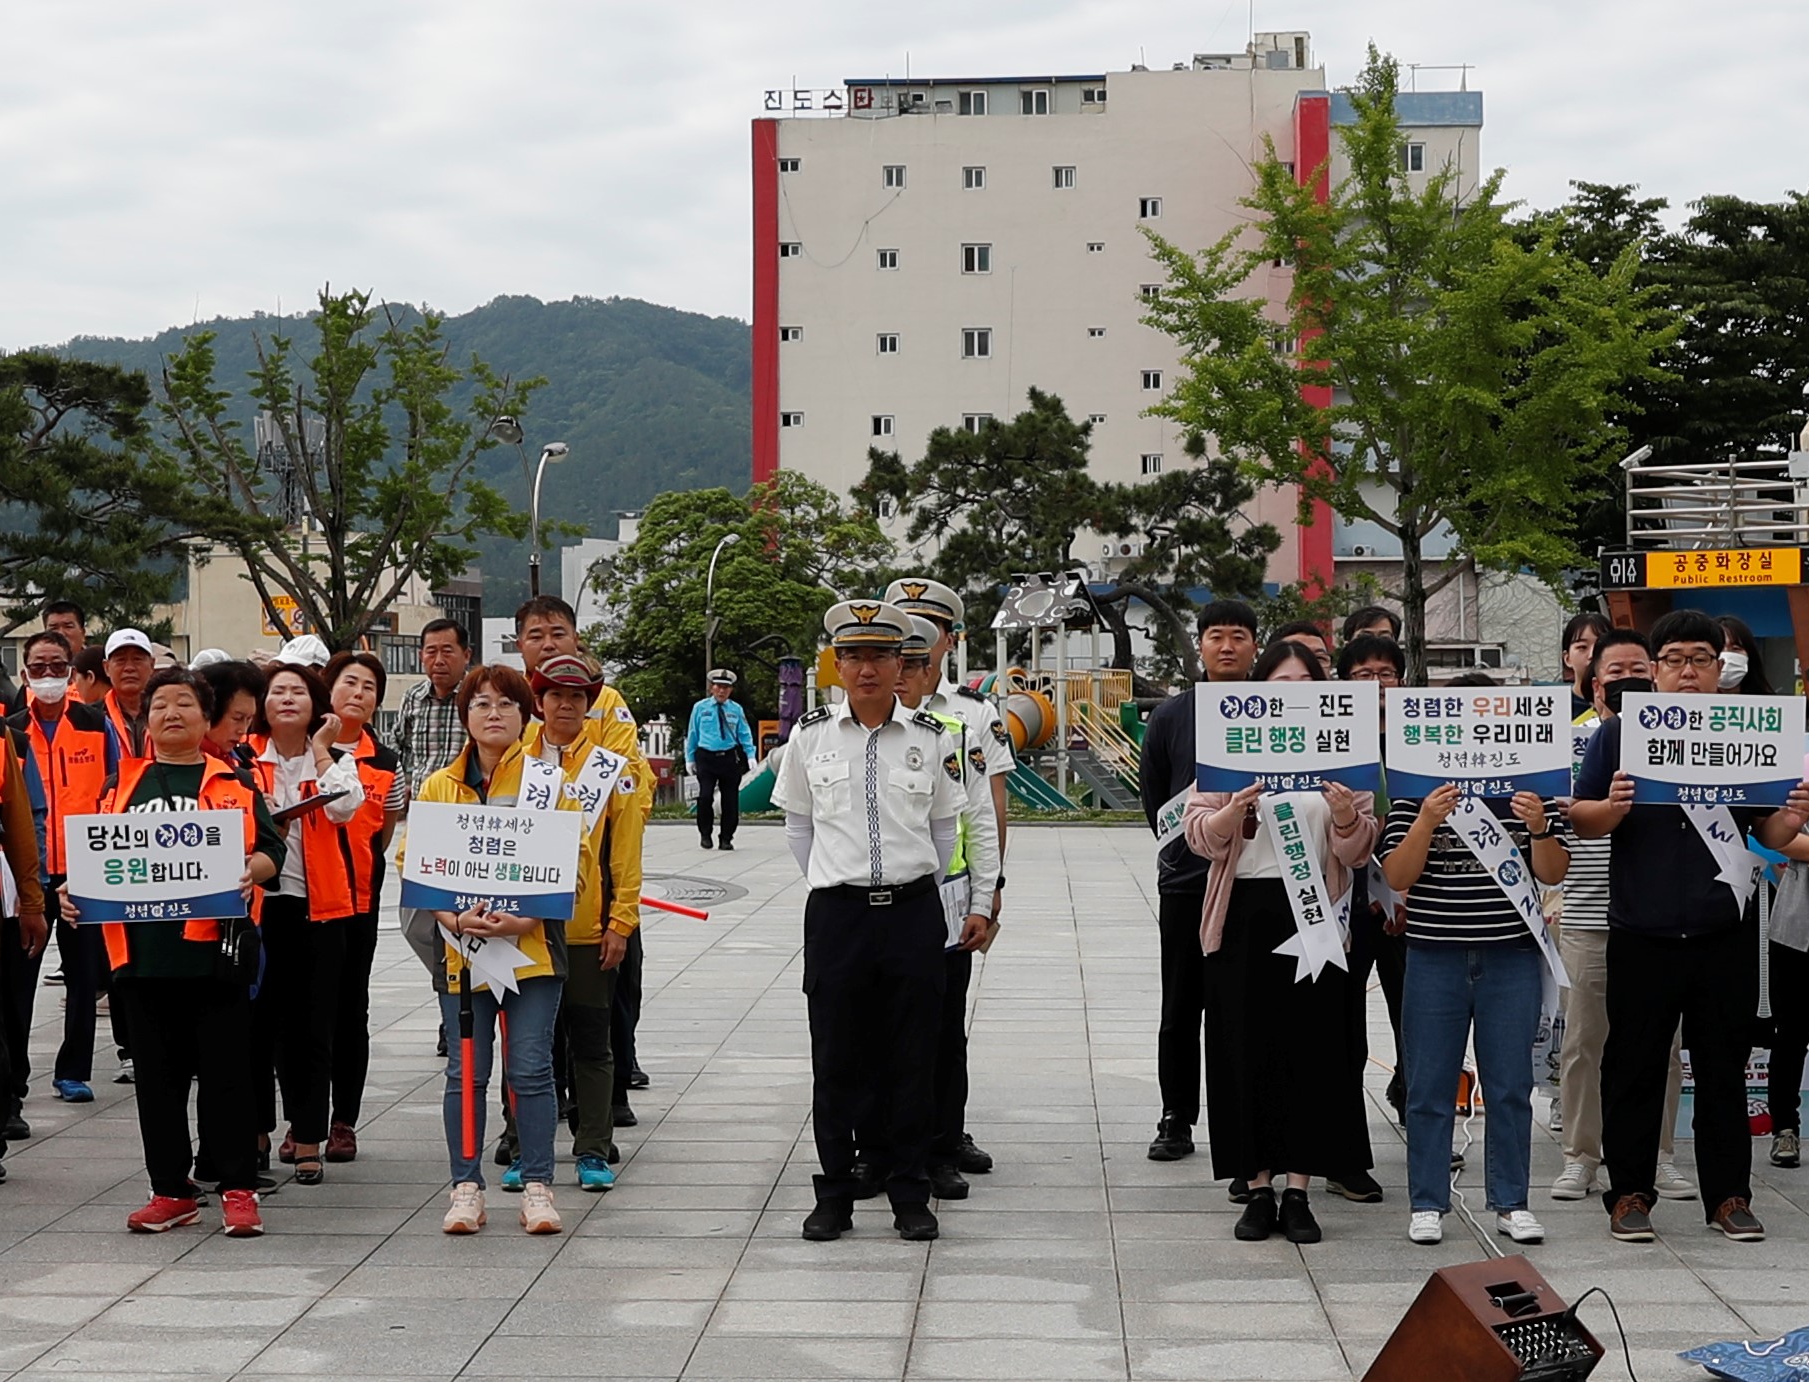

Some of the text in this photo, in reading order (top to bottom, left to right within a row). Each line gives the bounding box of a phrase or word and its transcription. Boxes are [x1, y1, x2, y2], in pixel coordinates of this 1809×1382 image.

[1673, 551, 1773, 573] 공중화장실
[1673, 573, 1773, 585] Public Restroom
[1319, 694, 1354, 718] 진도
[1403, 696, 1554, 718] 청렴한 우리세상
[1708, 705, 1782, 733] 공직사회
[1225, 726, 1350, 754] 클린 행정 실현
[1403, 723, 1554, 746] 행복한 우리미래
[1647, 738, 1777, 767] 함께 만들어가요
[87, 825, 149, 852] 당신의
[468, 835, 517, 857] 청렴은
[103, 858, 209, 885] 응원합니다.
[419, 857, 561, 884] 노력이 아닌 생활입니다
